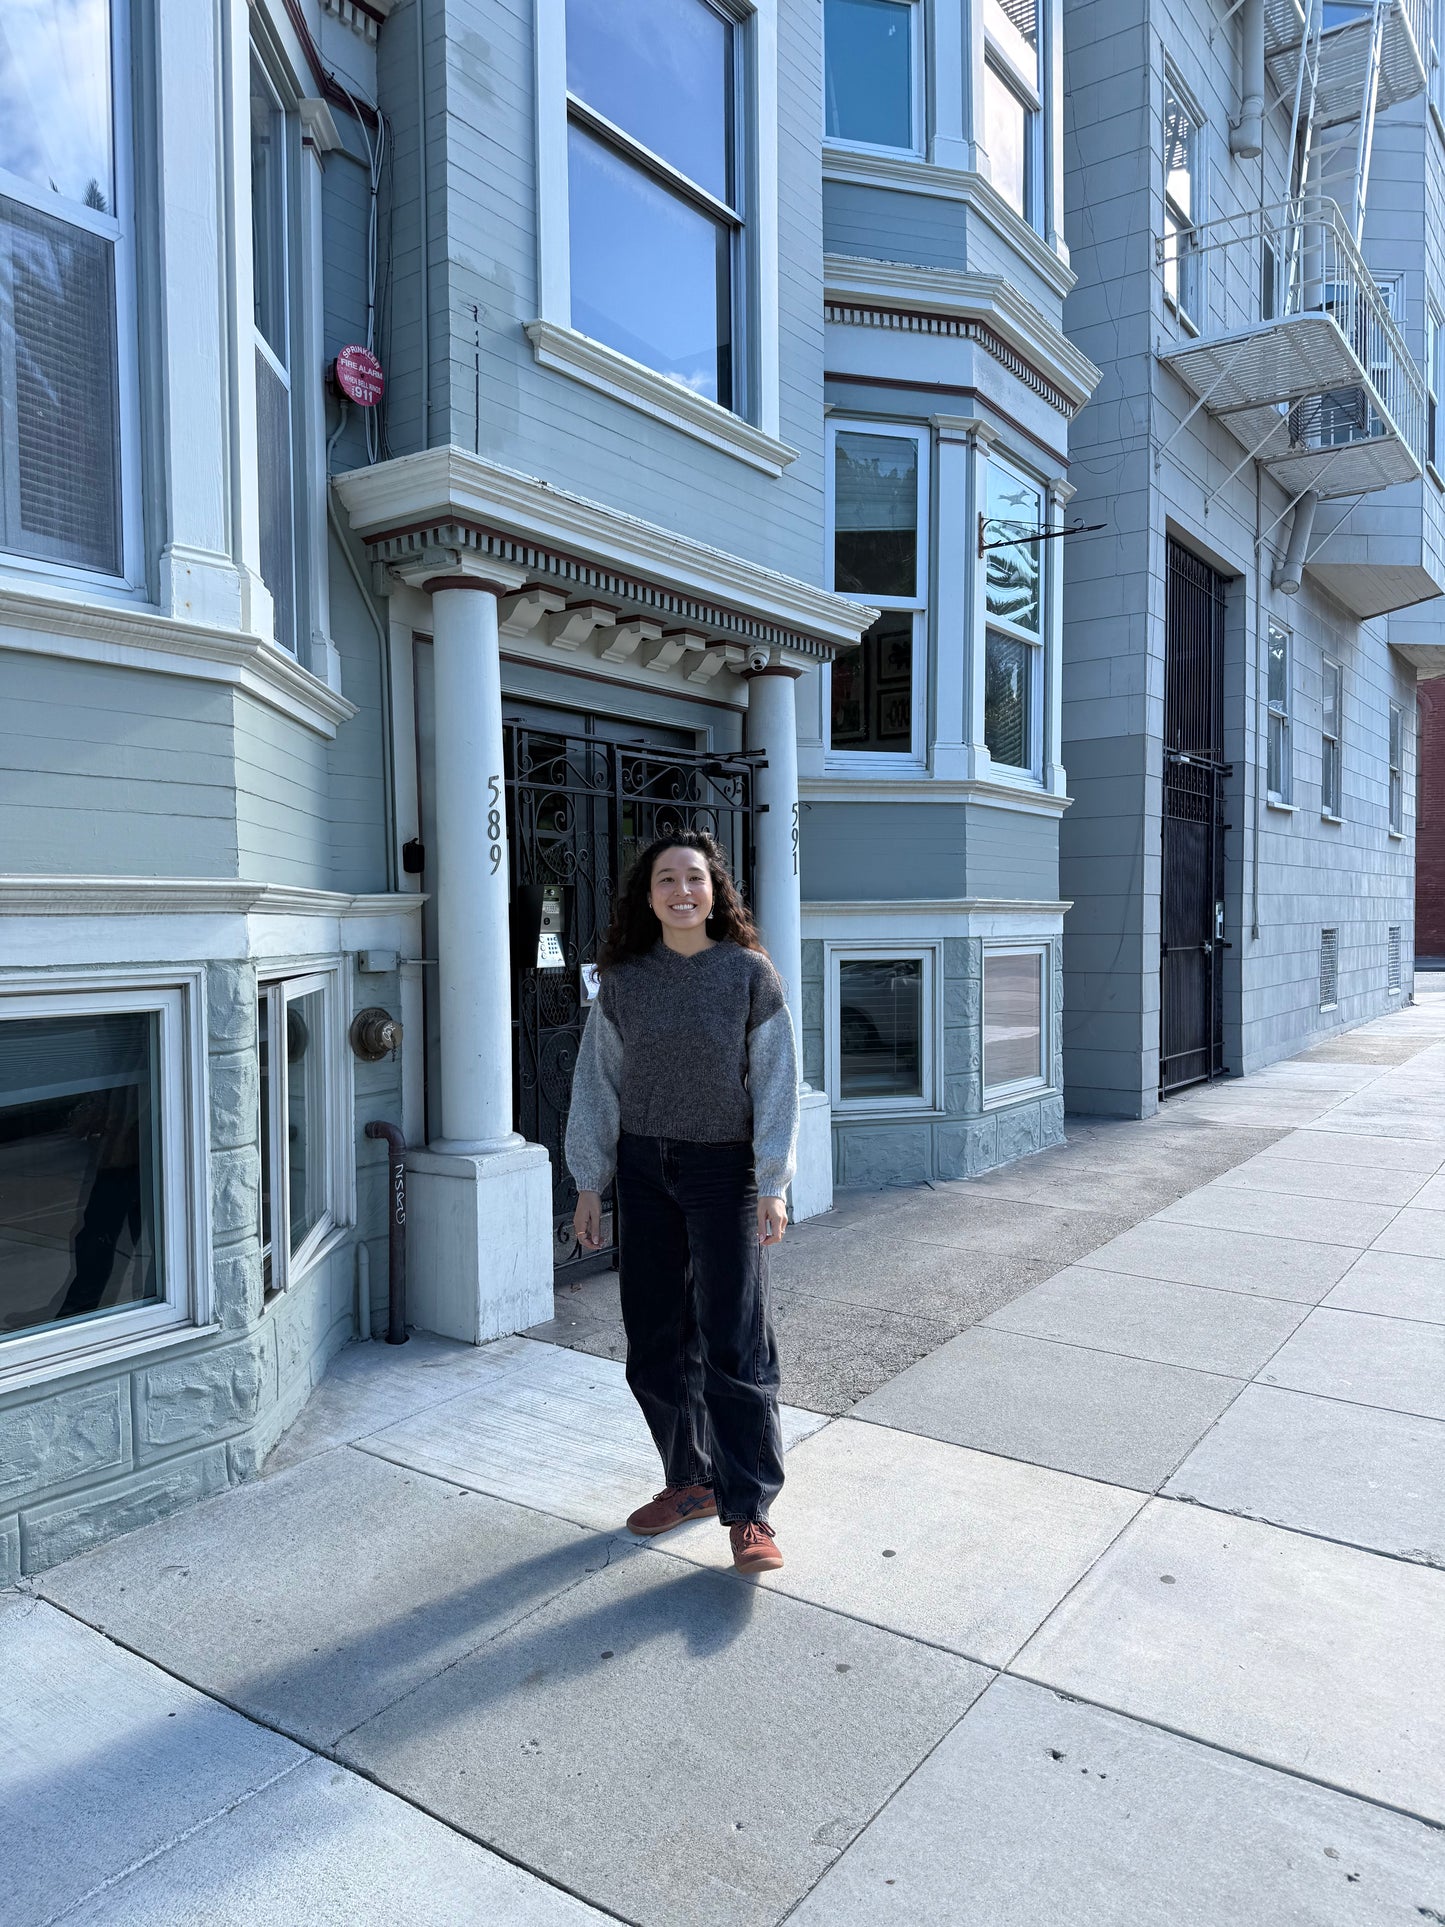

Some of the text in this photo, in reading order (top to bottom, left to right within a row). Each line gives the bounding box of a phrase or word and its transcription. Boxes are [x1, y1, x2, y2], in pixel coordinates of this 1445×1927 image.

[340, 358, 383, 380] FIRE ALARM
[342, 345, 380, 370] SPRINKLER
[343, 373, 358, 385] WHEN
[357, 379, 369, 389] BELL
[369, 383, 381, 394] RINGS
[355, 386, 373, 403] 911
[487, 774, 502, 876] 589
[791, 802, 799, 876] 591
